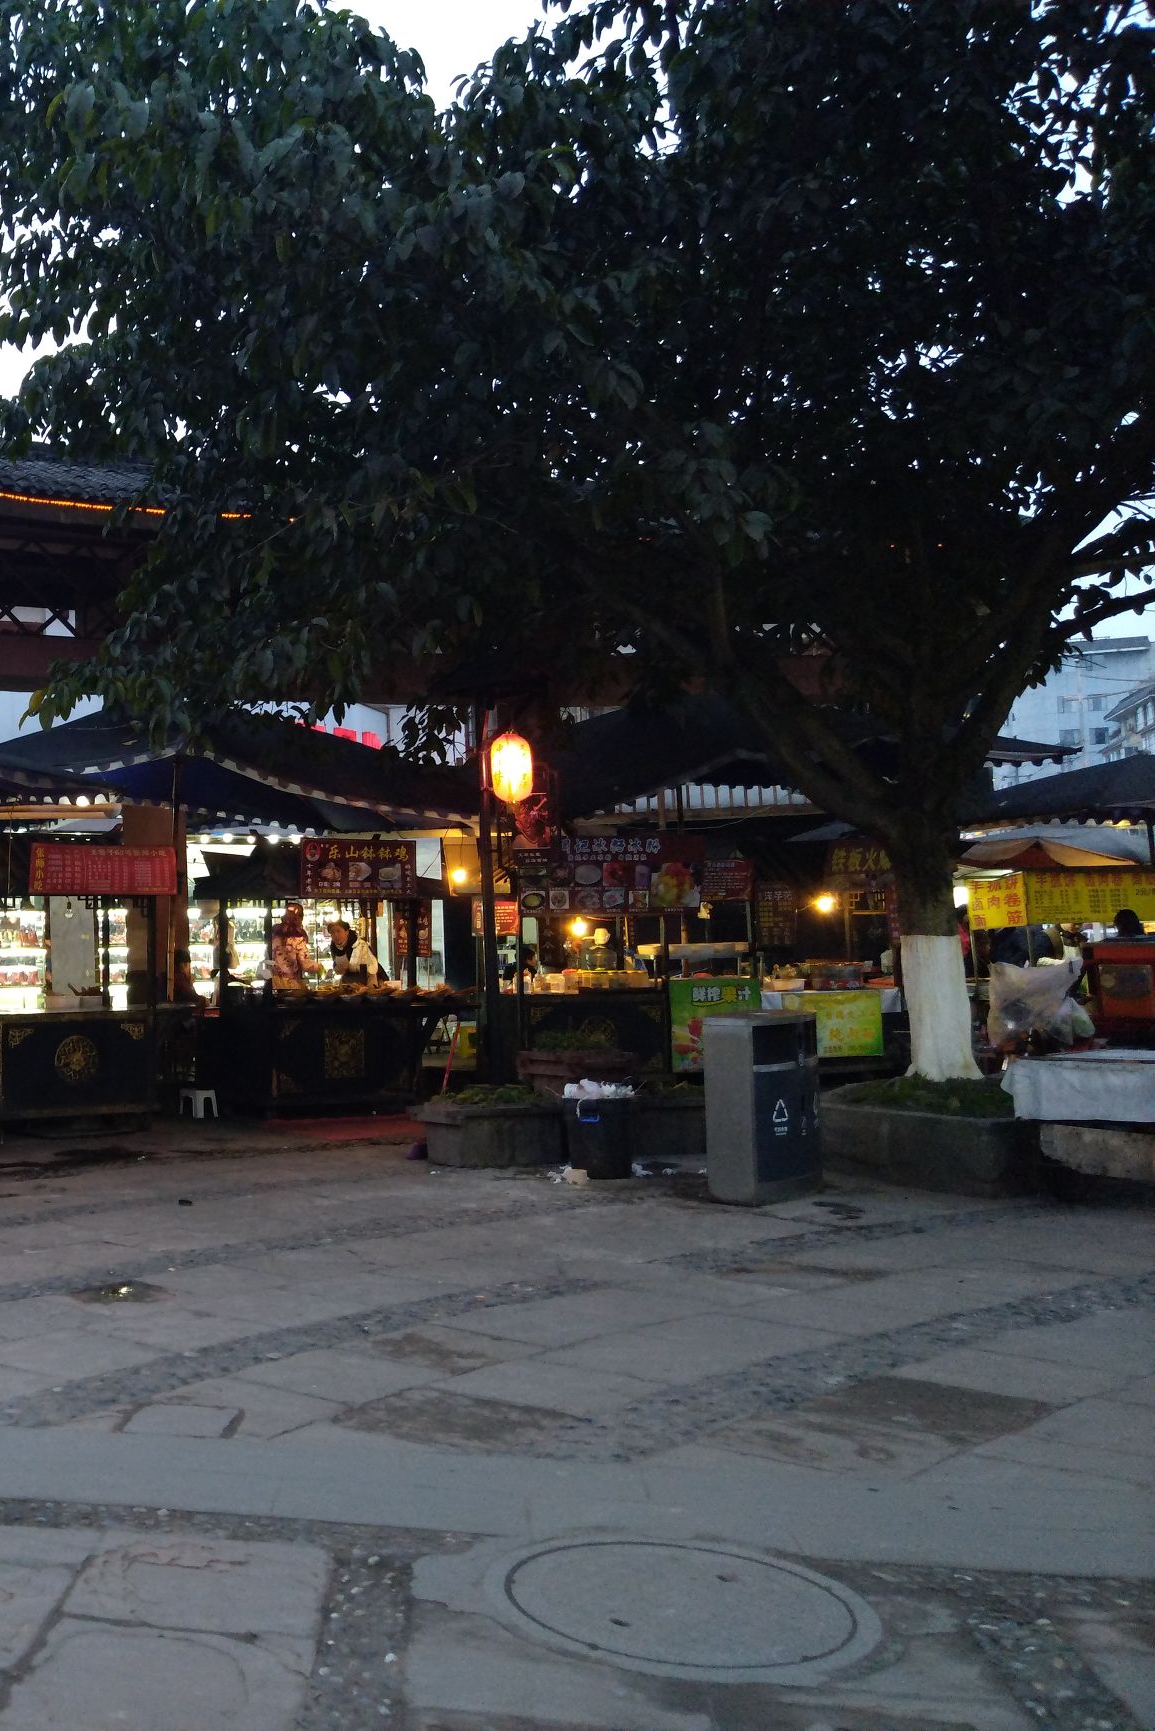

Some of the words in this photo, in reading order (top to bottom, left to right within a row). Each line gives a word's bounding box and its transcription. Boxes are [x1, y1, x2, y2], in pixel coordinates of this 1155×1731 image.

[328, 844, 409, 861] 乐山钵钵鸡
[970, 876, 1018, 895] 手抓饼
[972, 892, 1021, 911] 卤肉卷
[692, 985, 751, 1004] 鲜榨果汁
